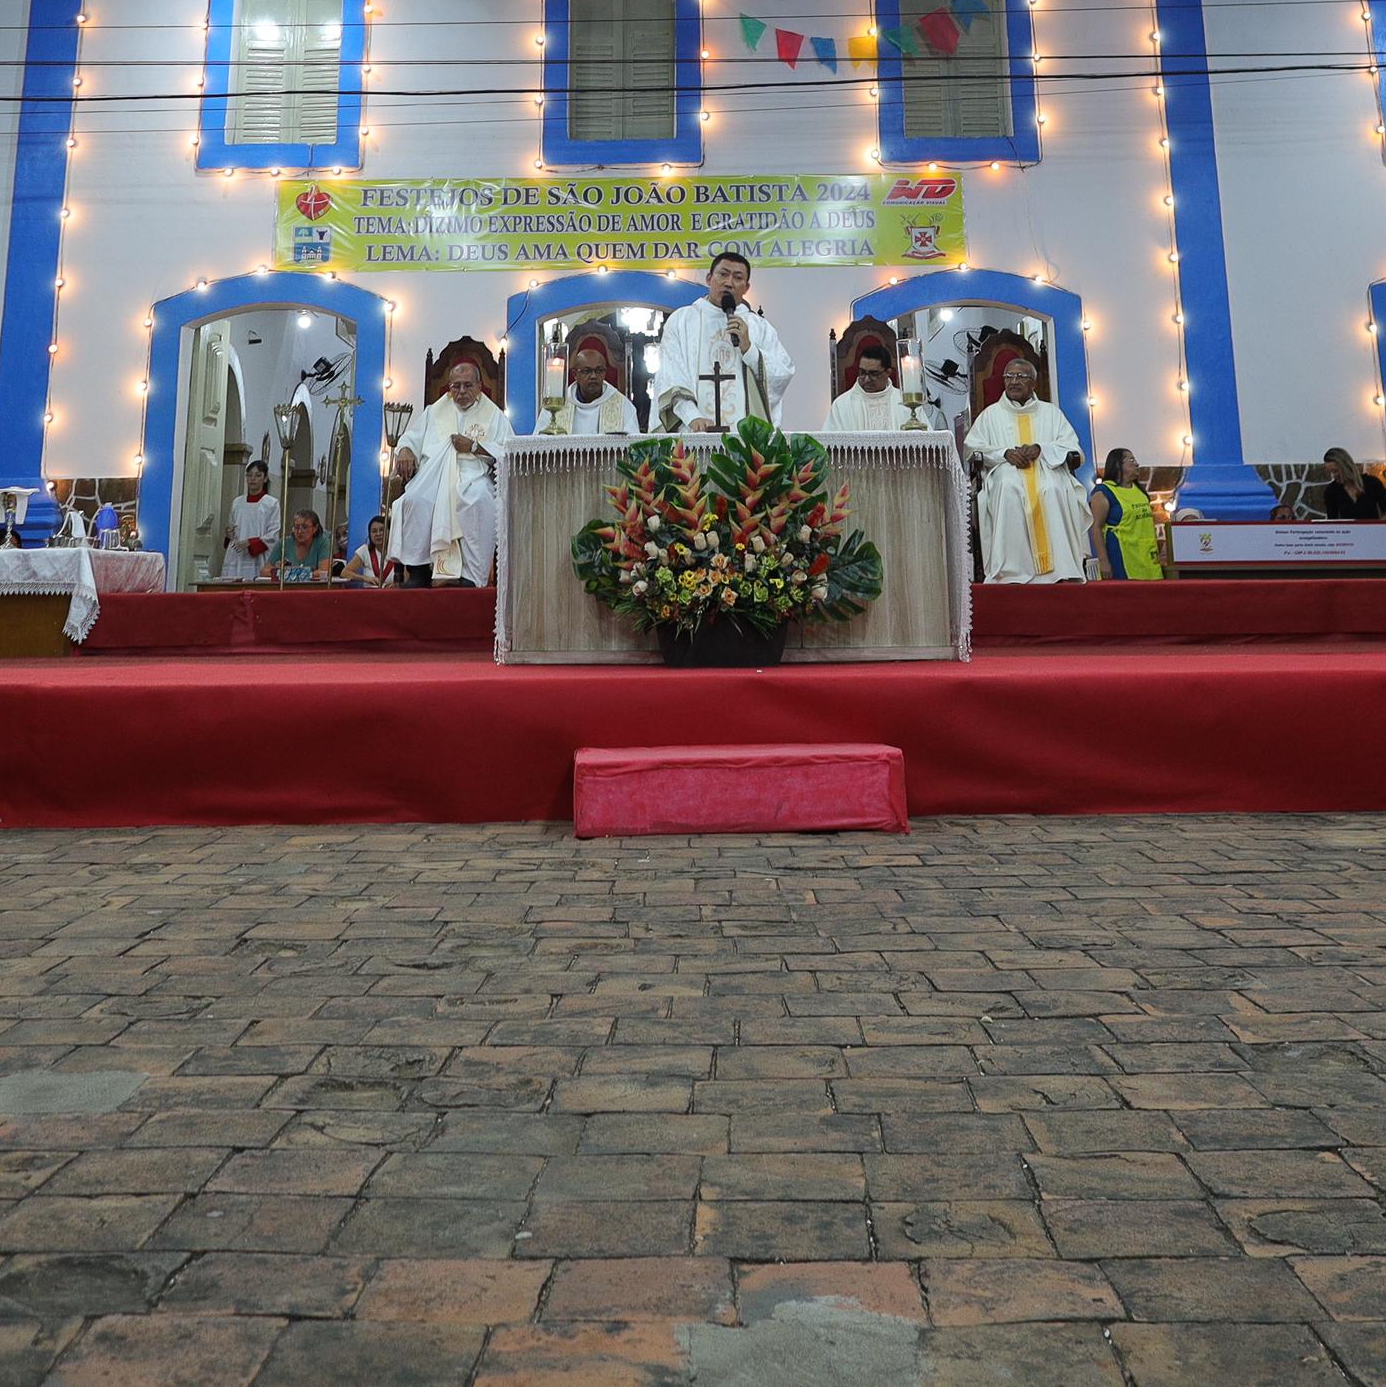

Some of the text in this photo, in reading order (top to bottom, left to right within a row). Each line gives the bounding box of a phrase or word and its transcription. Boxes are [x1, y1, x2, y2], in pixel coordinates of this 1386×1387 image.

[360, 181, 871, 207] FESTEJOS DE SÃO JOÃO BATISTA 2024
[488, 211, 592, 233] EXPRESSÃO
[596, 214, 622, 231] DE
[626, 213, 683, 231] AMOR
[691, 214, 702, 231] E
[707, 208, 805, 231] GRATIDÃO
[810, 211, 823, 230] A
[828, 210, 876, 229] DEUS
[365, 244, 441, 262] LEMA:
[447, 243, 509, 261] DEUS
[515, 243, 570, 261] AMA
[576, 242, 647, 263] QUEM
[652, 242, 702, 259] DAR
[769, 239, 875, 258] ALEGRIA
